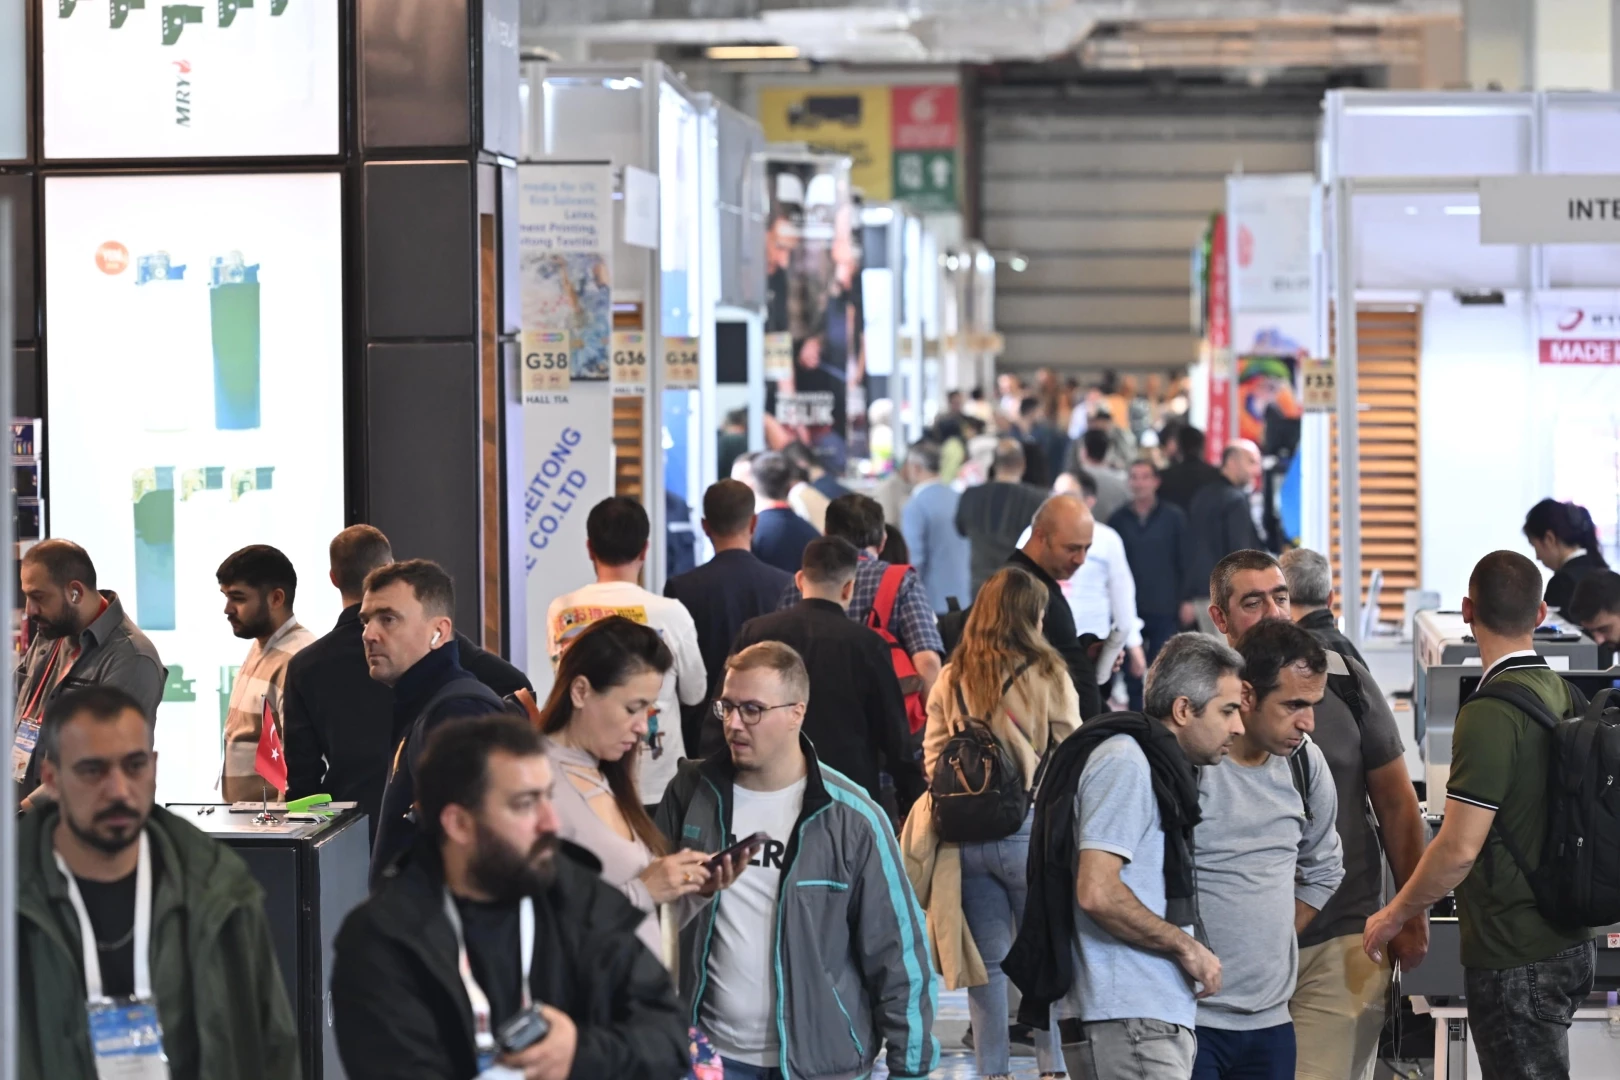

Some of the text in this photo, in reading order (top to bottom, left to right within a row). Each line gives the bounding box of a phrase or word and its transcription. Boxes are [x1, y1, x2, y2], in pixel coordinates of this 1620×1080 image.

[176, 75, 190, 128] MRY
[526, 352, 568, 370] G38
[613, 350, 646, 366] G36
[1551, 341, 1612, 363] MADE
[526, 396, 551, 404] HALL
